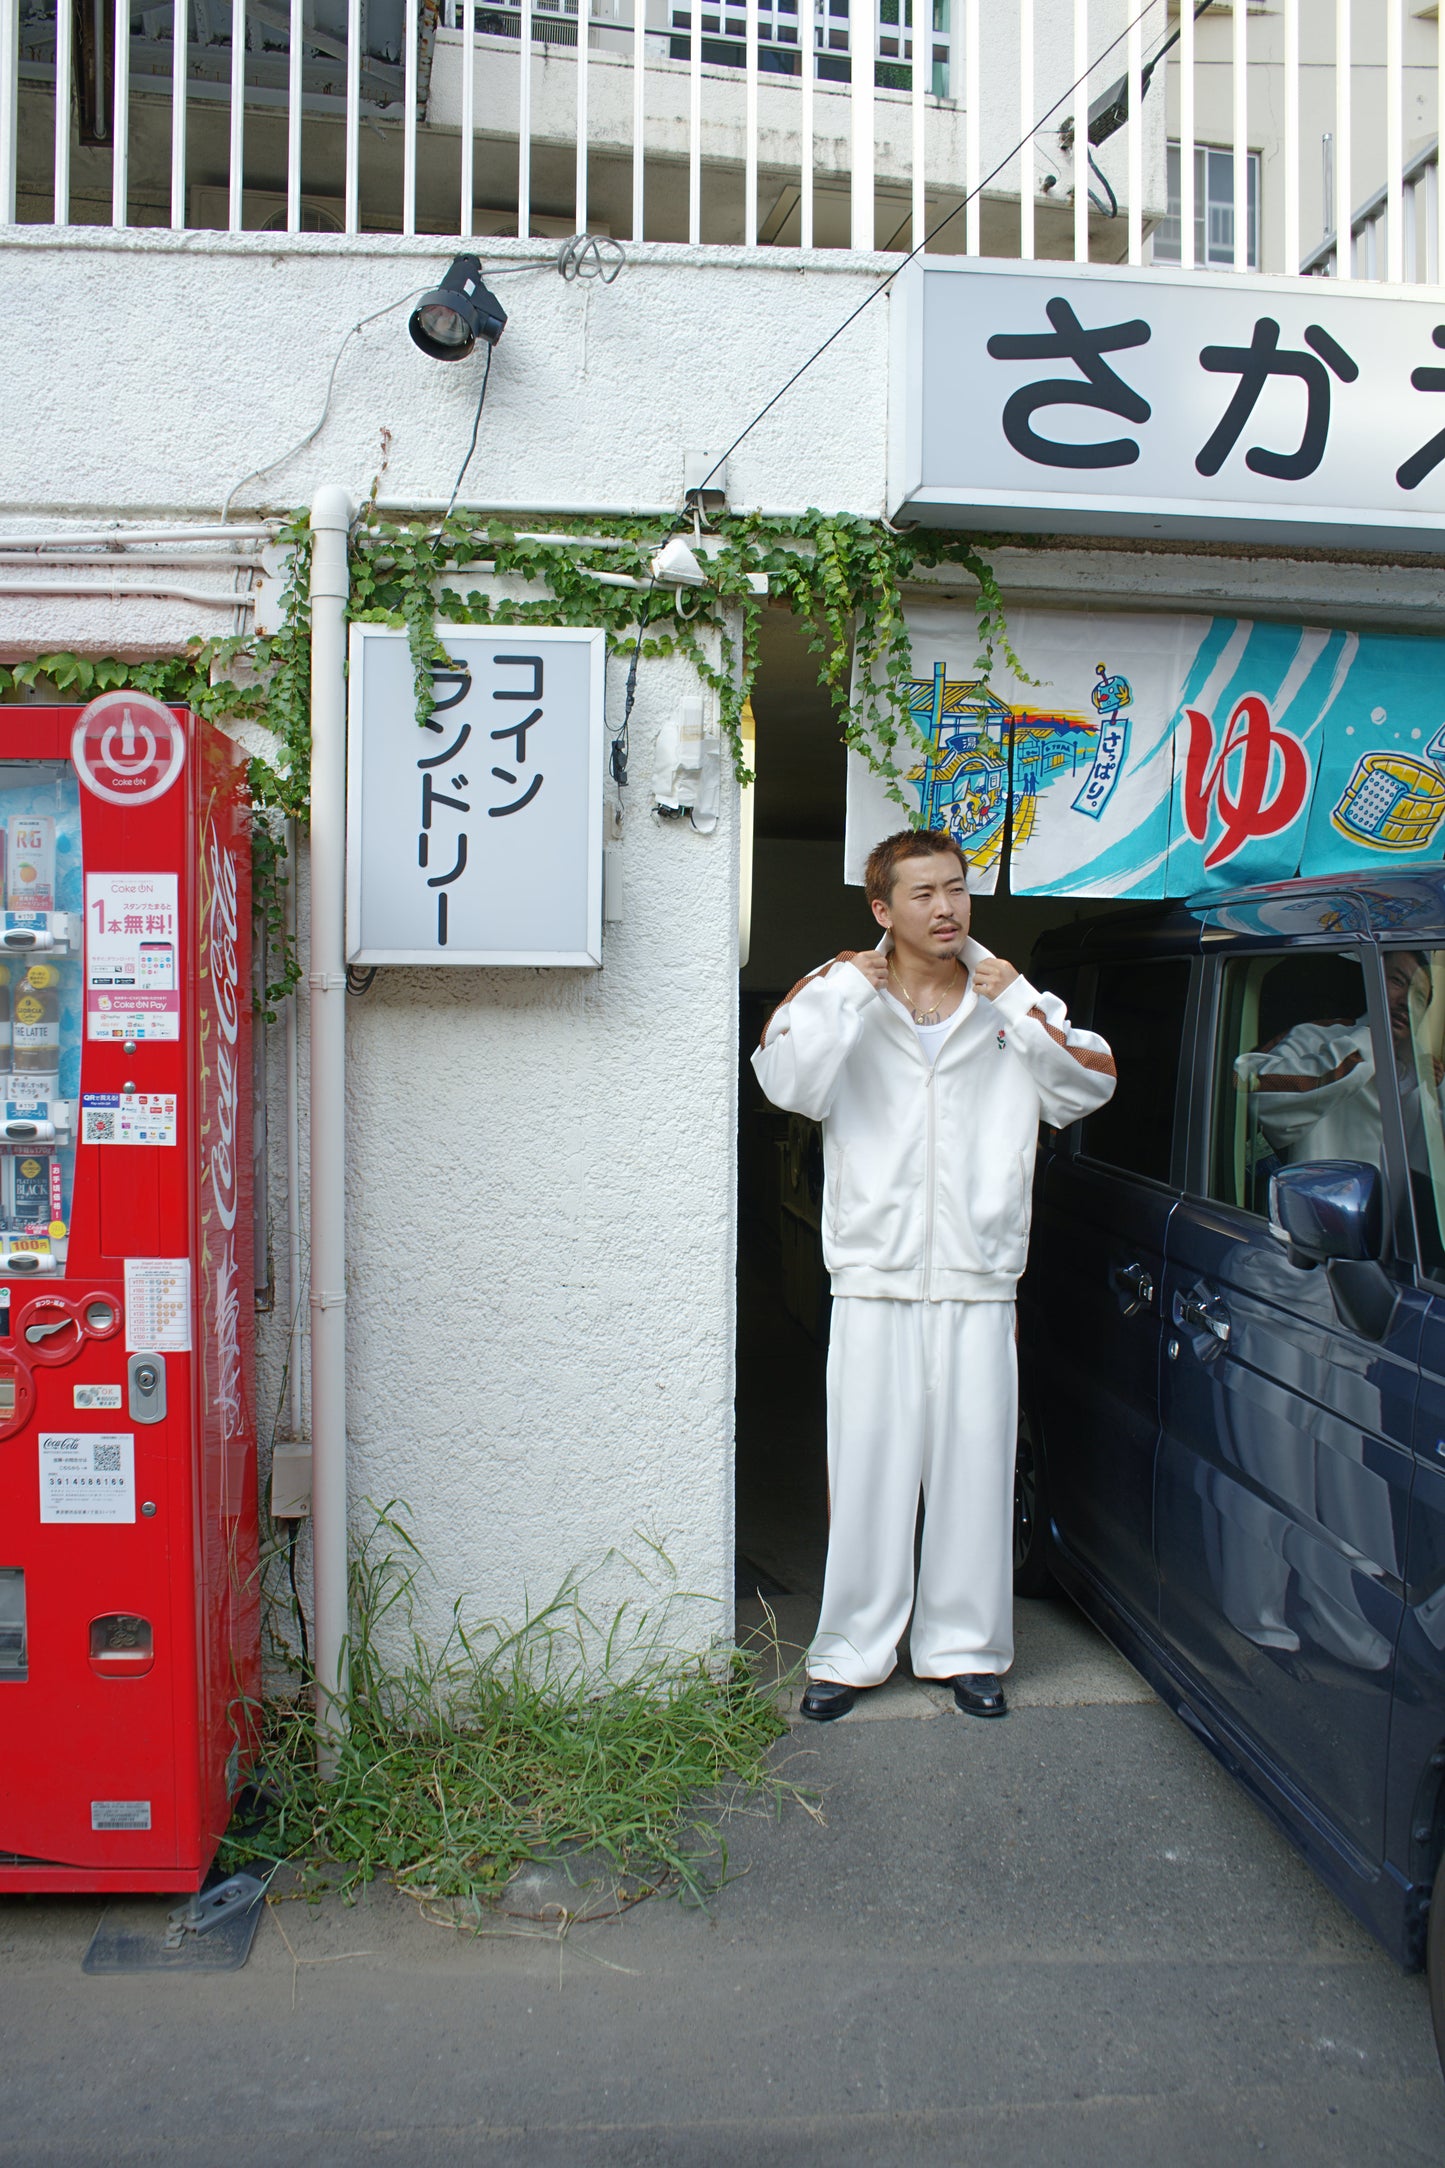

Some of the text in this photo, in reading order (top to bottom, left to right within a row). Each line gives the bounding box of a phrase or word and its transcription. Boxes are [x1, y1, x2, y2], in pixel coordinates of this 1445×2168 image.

[489, 654, 544, 818] コイン
[962, 736, 977, 750] 湯
[112, 777, 146, 786] Coke ON
[1184, 696, 1308, 868] ゆ
[415, 659, 473, 946] ランドリー
[17, 830, 42, 849] RG
[111, 884, 154, 893] Coke ON
[123, 903, 172, 911] スタンプたまると
[113, 1000, 167, 1010] Coke ON Pay
[211, 816, 239, 1232] Coca-Cola
[26, 1026, 48, 1037] LATTE
[16, 1184, 48, 1196] BLACK
[12, 1240, 48, 1251] 100円
